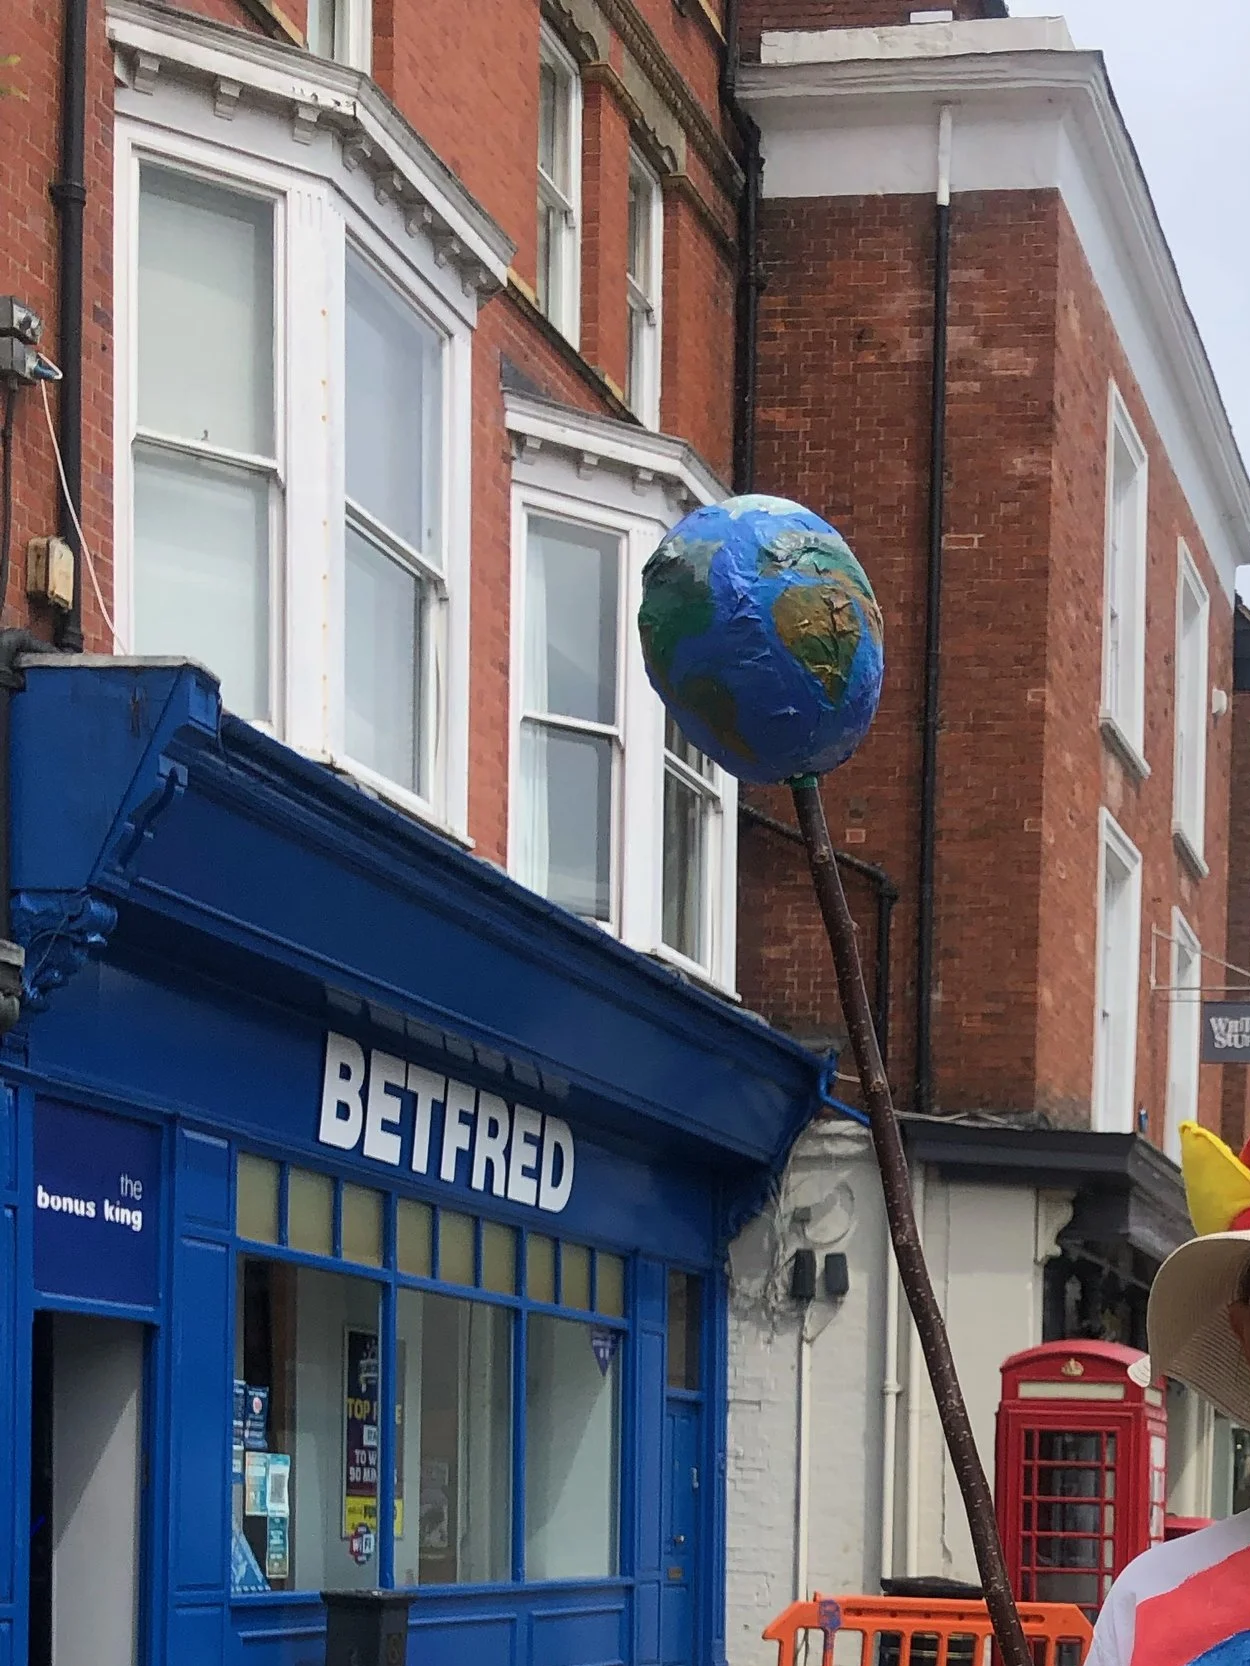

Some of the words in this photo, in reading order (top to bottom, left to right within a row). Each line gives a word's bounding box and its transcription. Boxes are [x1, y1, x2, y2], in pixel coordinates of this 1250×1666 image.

[318, 1030, 575, 1214] BETFRED
[36, 1184, 96, 1219] bonus
[103, 1199, 143, 1232] king
[120, 1173, 143, 1200] the
